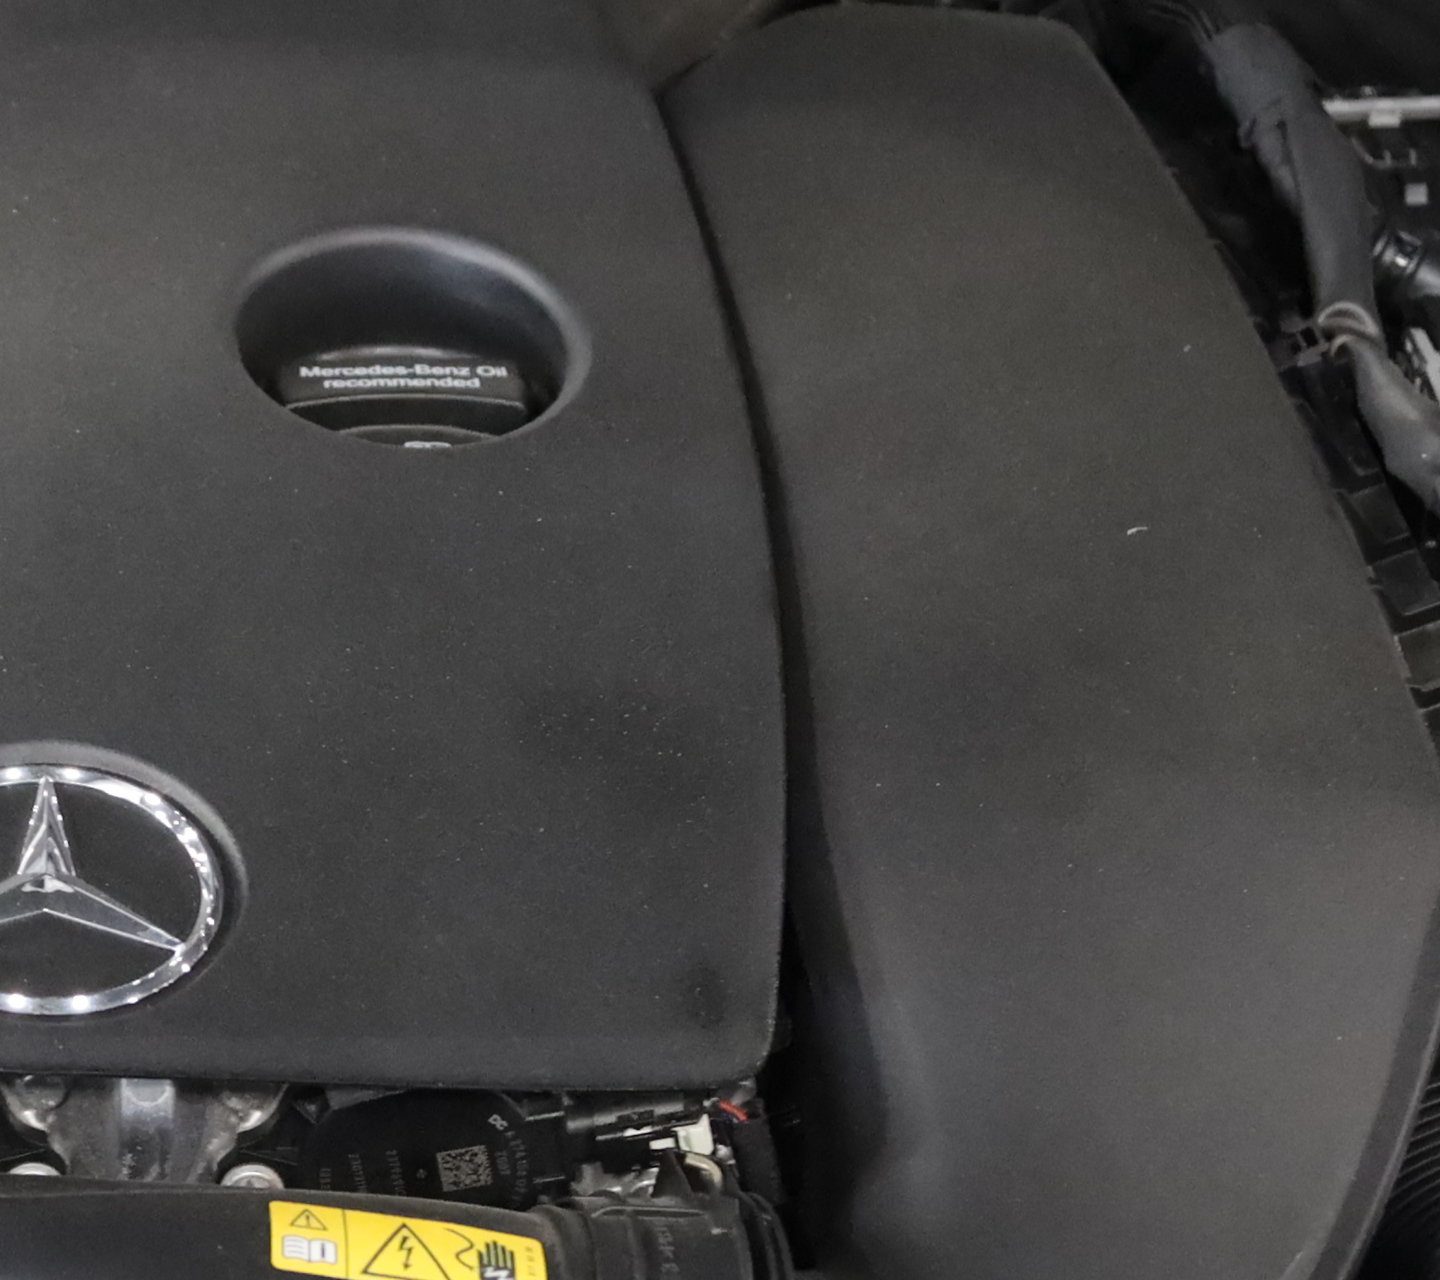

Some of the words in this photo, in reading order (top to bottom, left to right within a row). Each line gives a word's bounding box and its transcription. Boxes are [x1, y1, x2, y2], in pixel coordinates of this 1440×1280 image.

[299, 364, 470, 378] Mercedes-Benz
[476, 365, 508, 378] Oil
[323, 377, 480, 389] recommended
